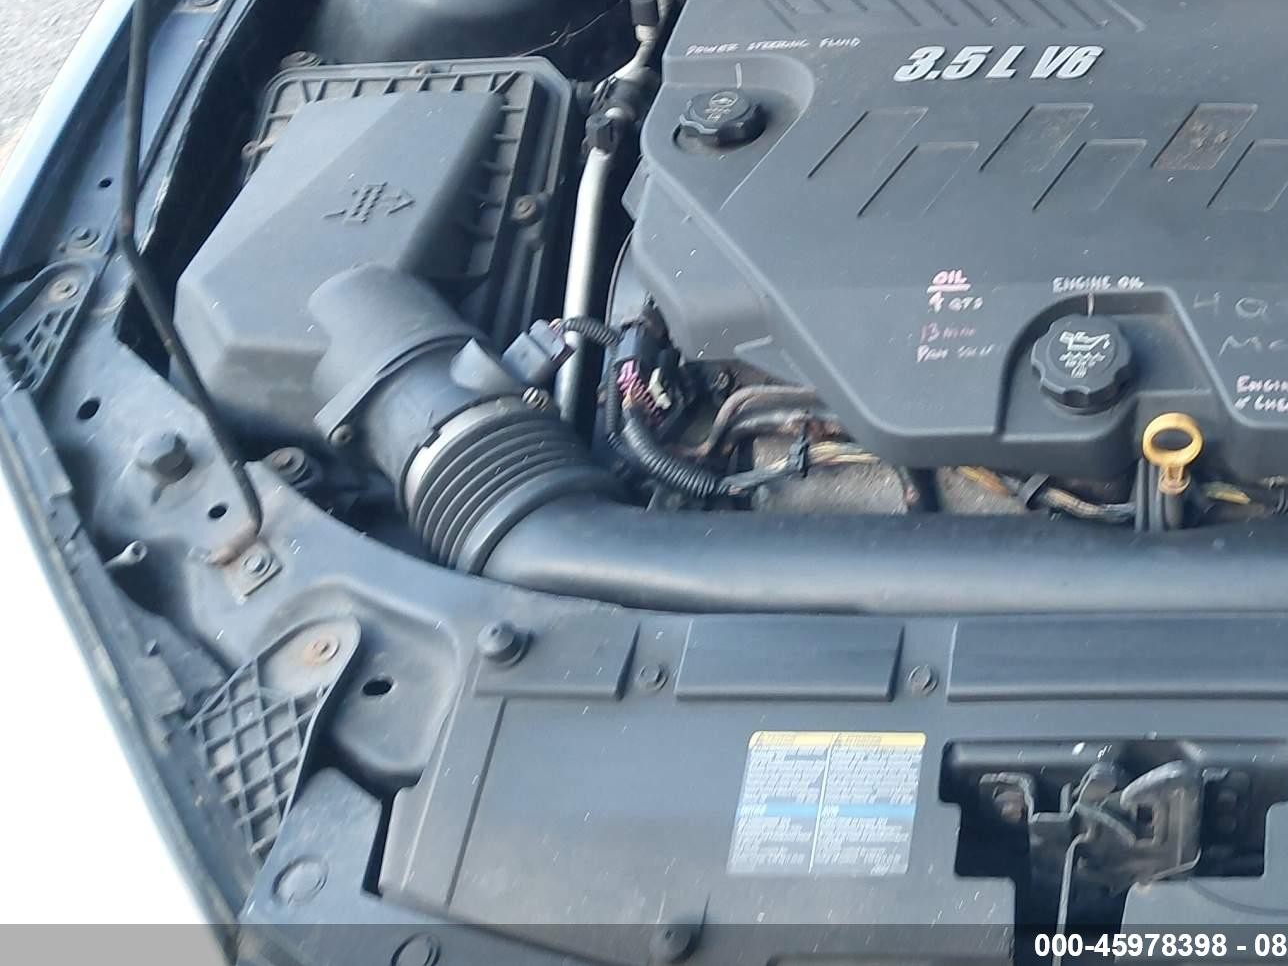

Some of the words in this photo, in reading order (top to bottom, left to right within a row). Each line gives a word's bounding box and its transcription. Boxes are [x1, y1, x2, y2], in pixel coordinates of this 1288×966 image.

[819, 36, 862, 49] FLUID
[893, 46, 993, 82] 3.5
[1029, 45, 1105, 81] V6
[932, 269, 968, 285] OIL
[1053, 276, 1111, 293] ENGINE
